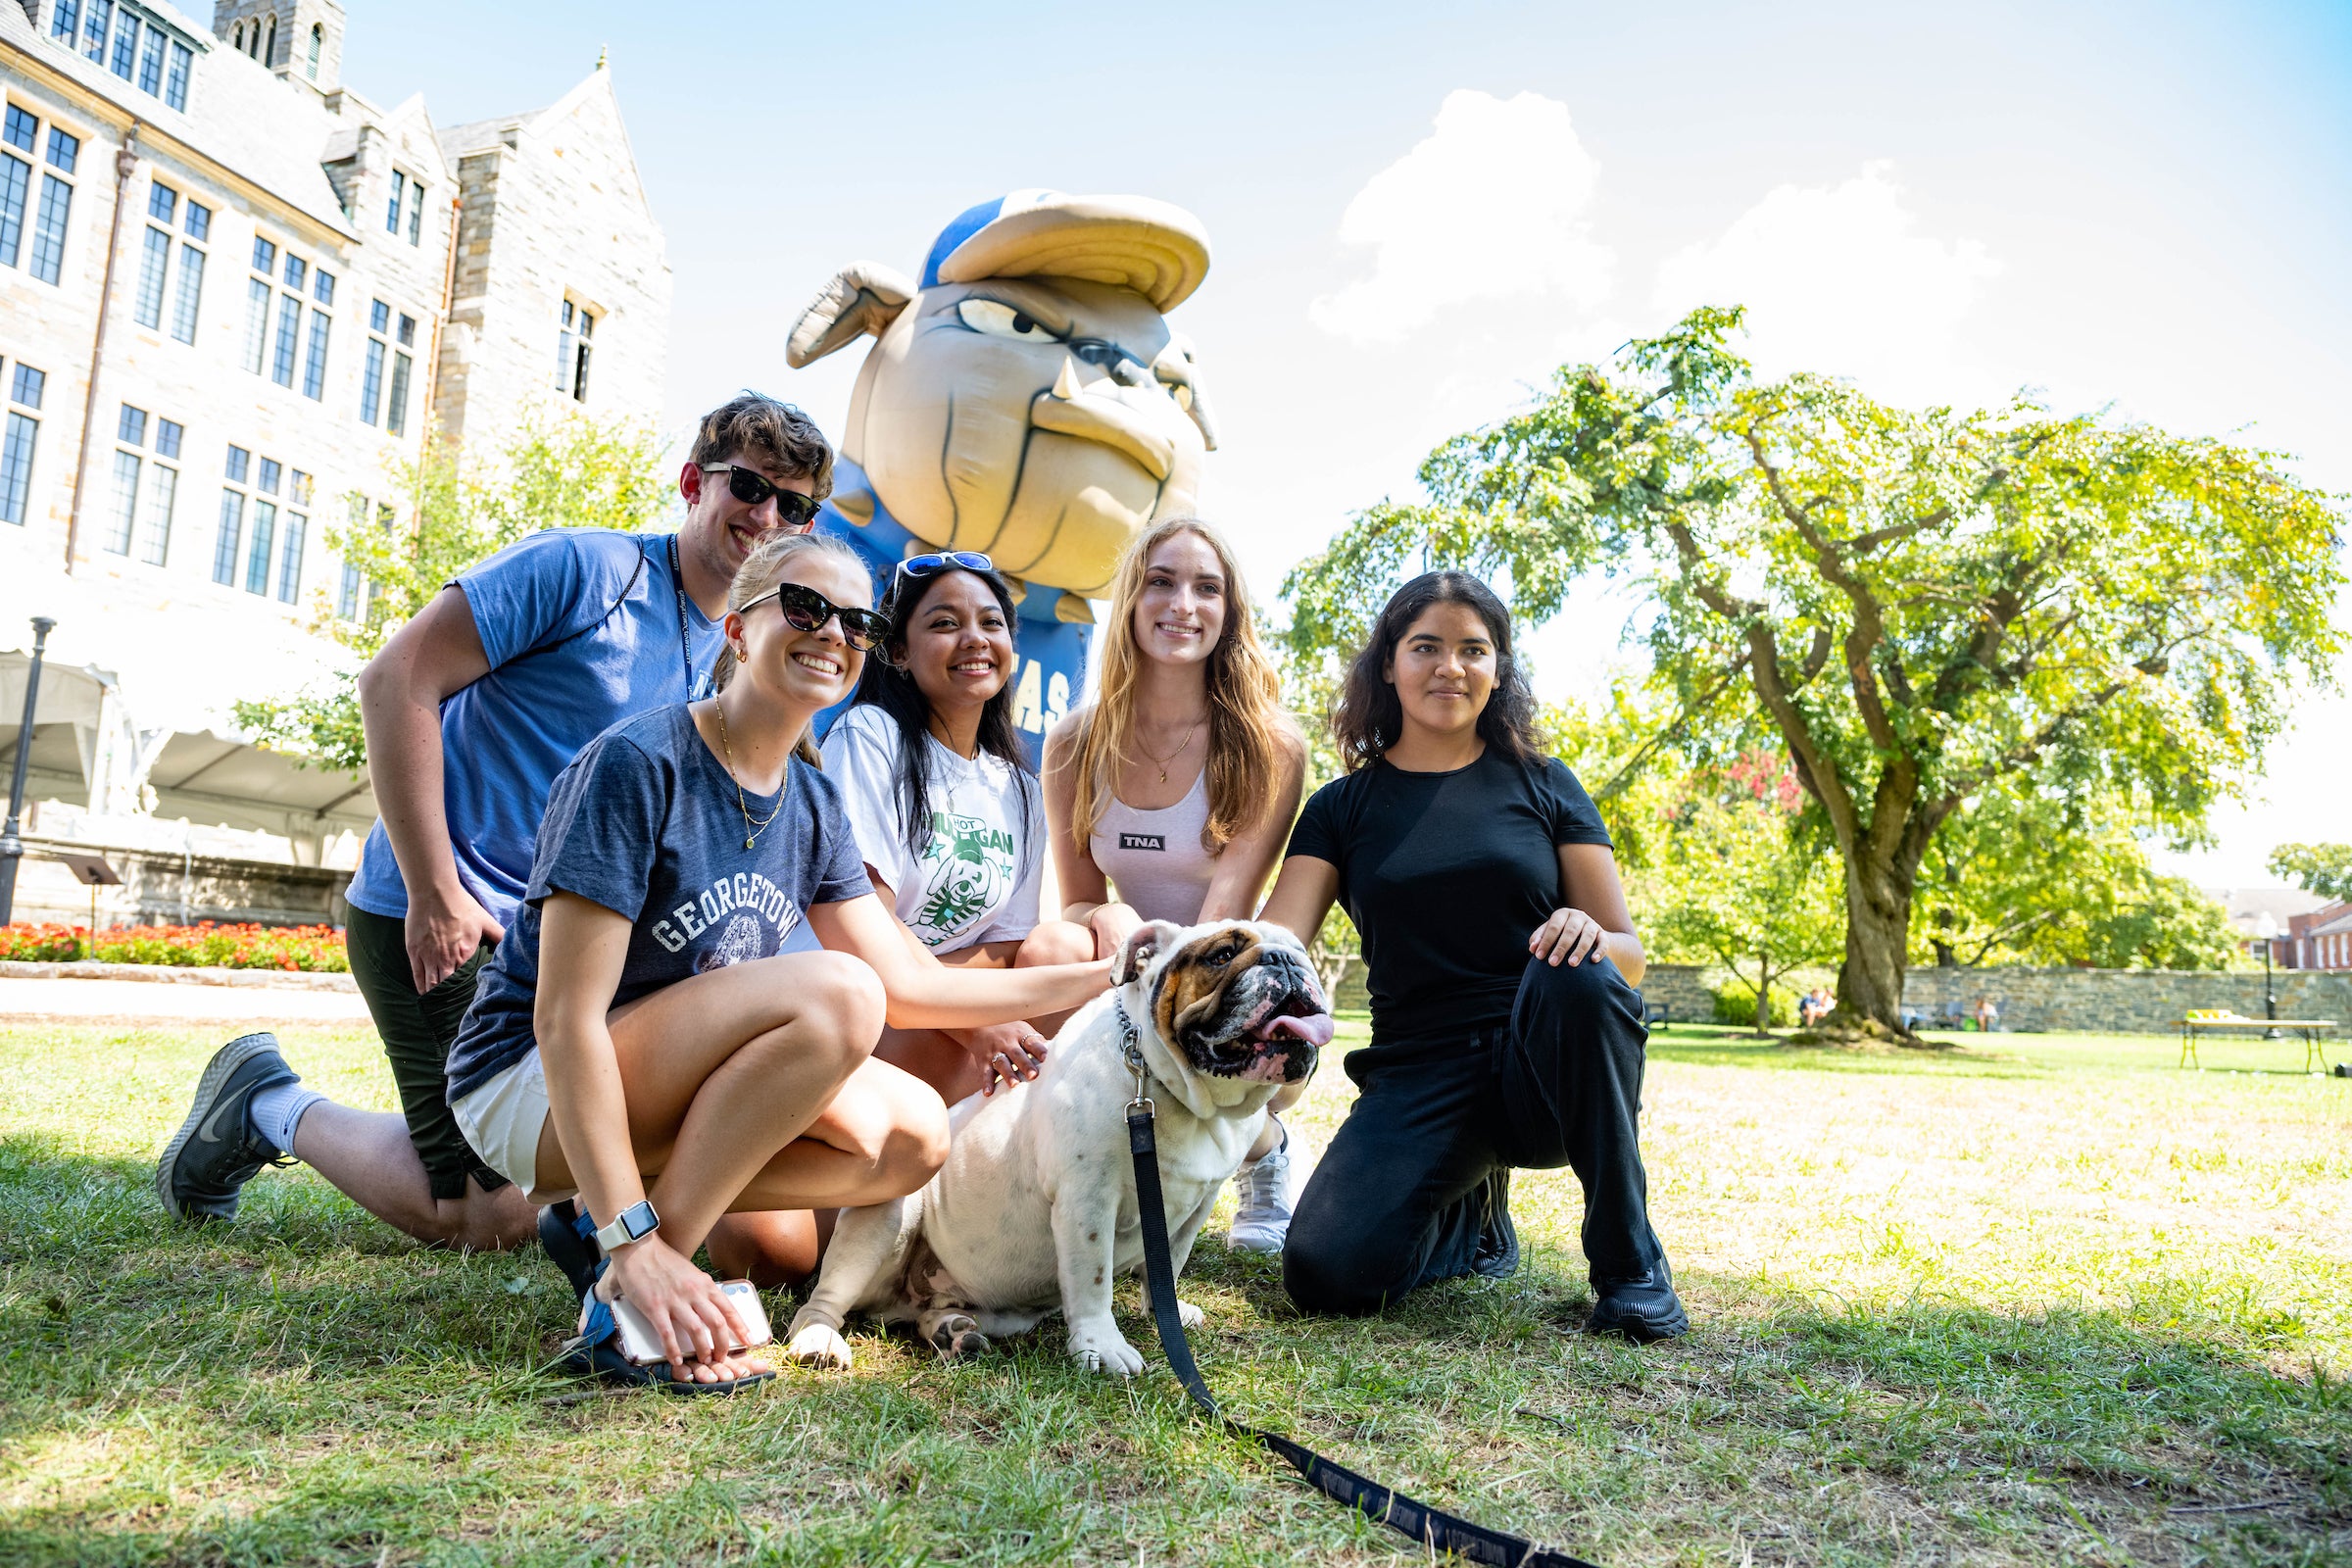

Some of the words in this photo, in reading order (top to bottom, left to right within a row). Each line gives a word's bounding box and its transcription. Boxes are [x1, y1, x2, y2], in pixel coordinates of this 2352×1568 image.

[1010, 652, 1070, 737] AS
[953, 818, 975, 830] HOT
[1123, 836, 1161, 849] TNA
